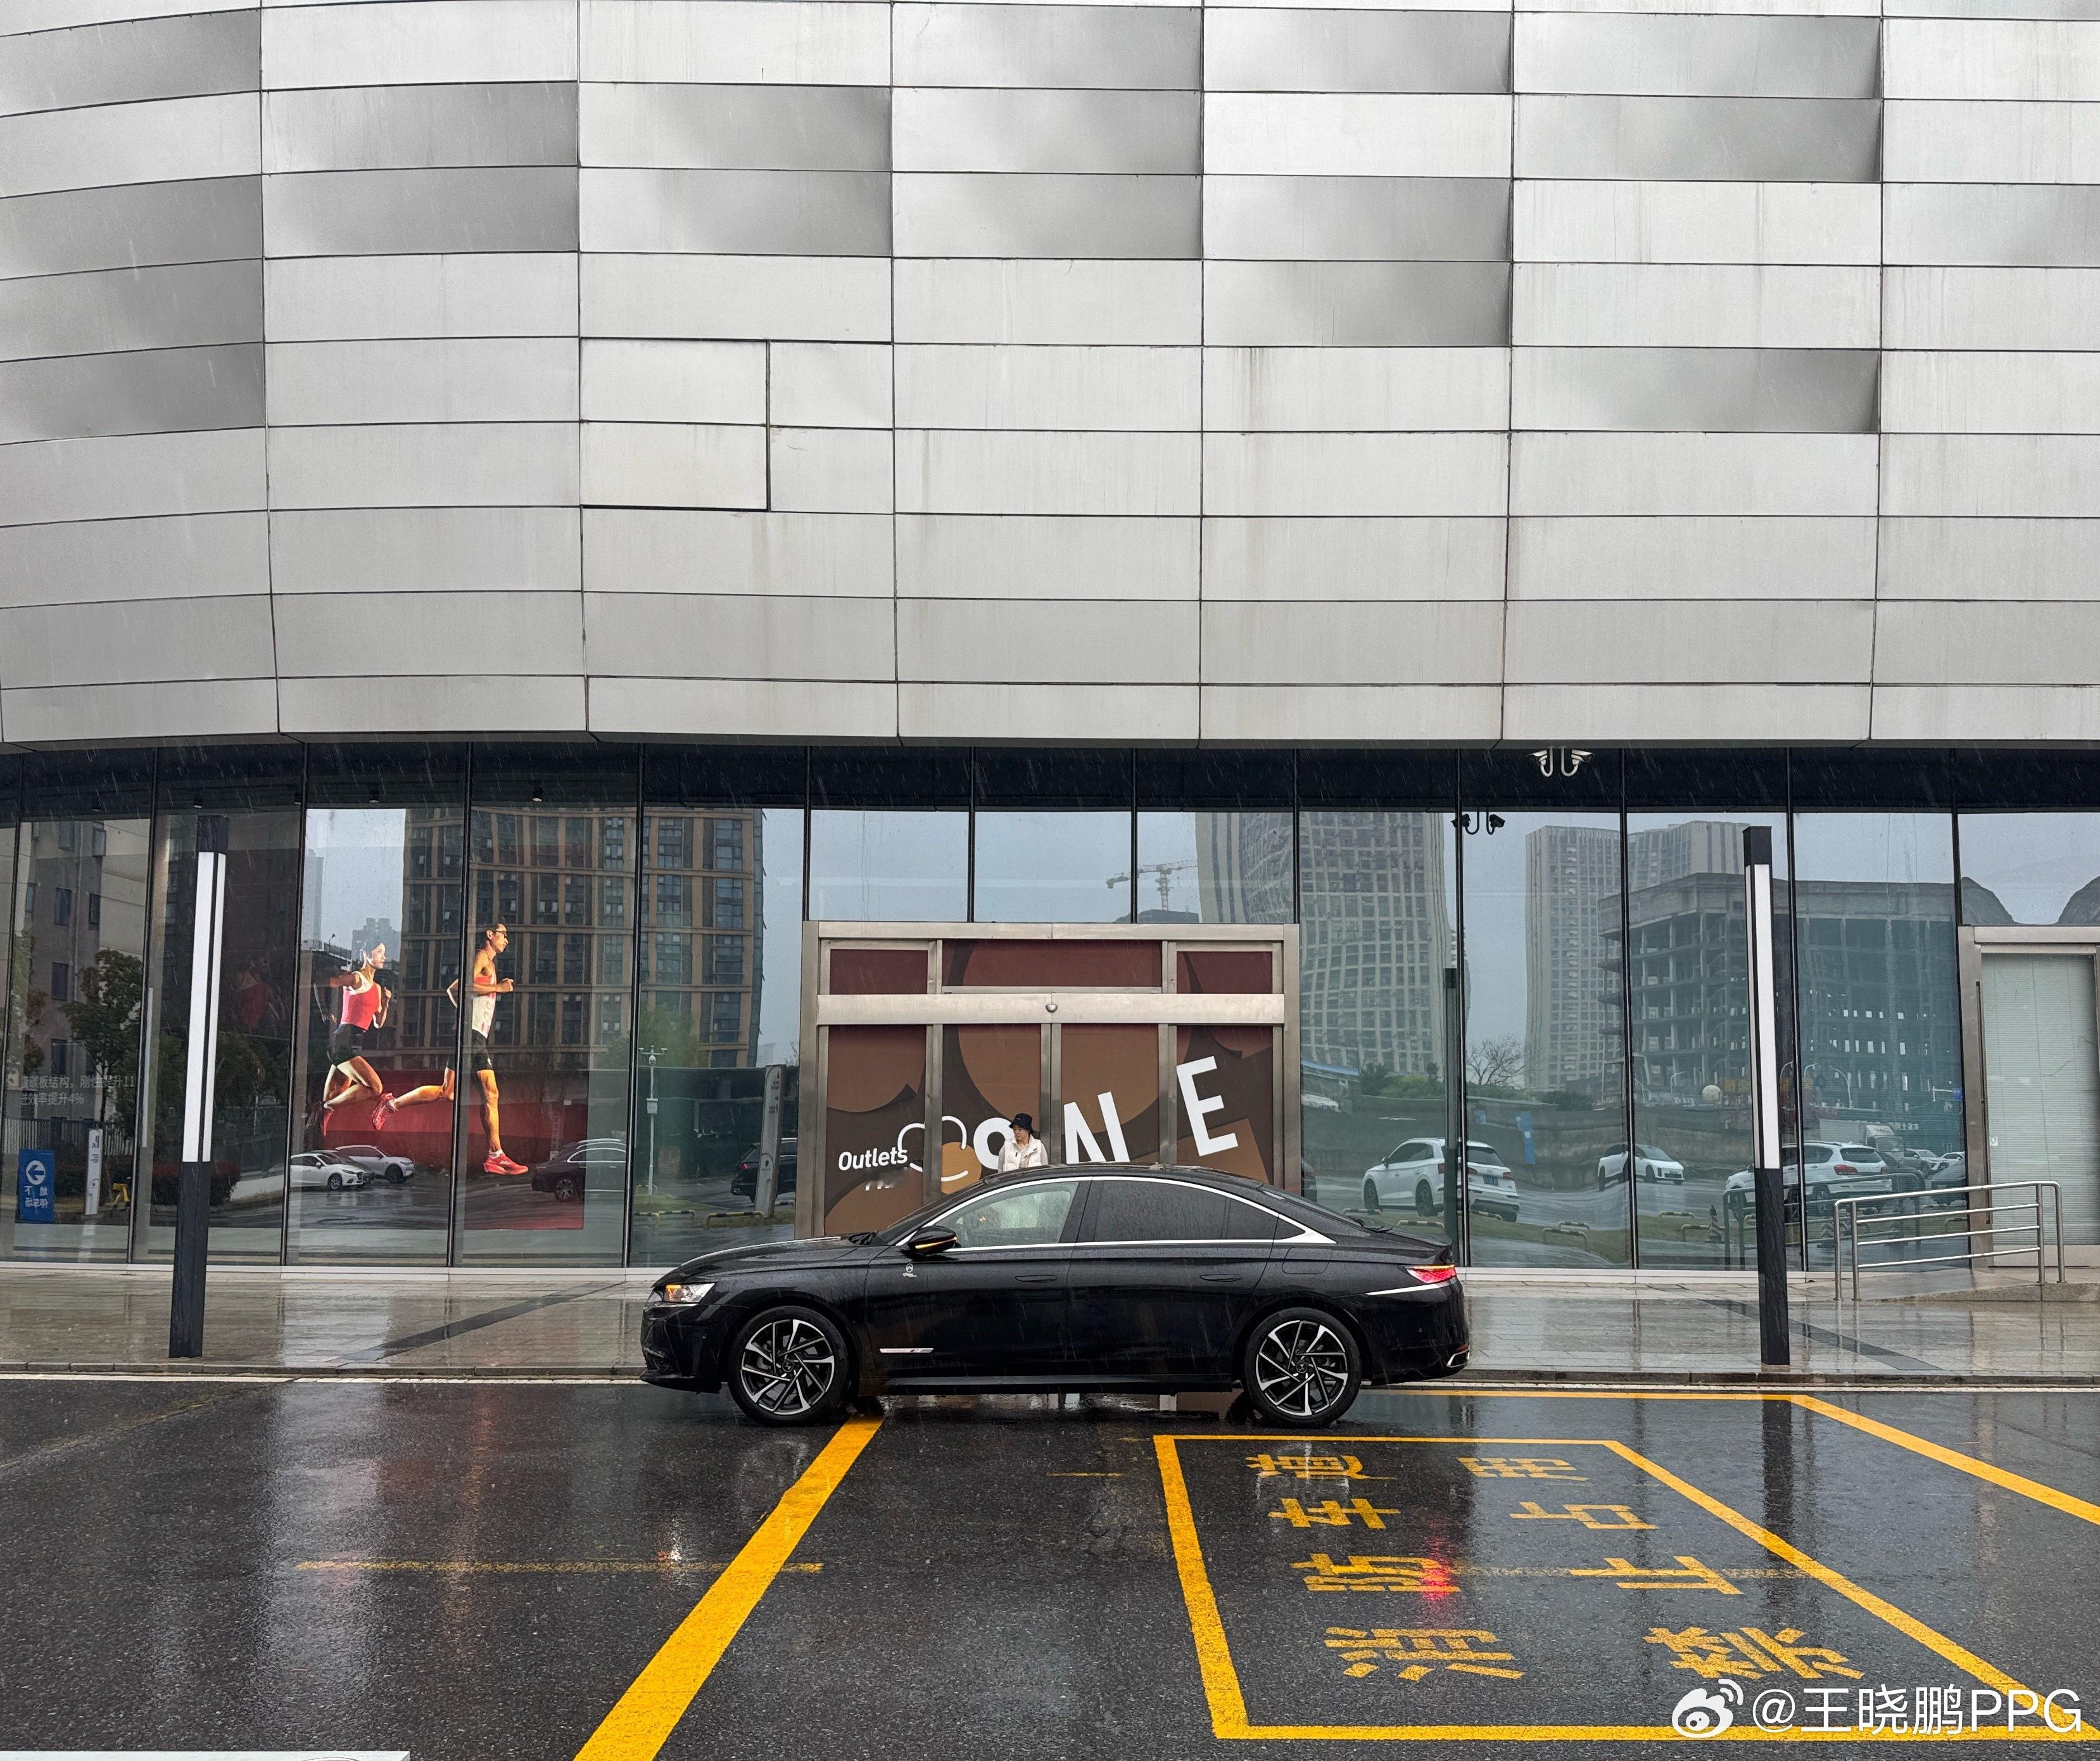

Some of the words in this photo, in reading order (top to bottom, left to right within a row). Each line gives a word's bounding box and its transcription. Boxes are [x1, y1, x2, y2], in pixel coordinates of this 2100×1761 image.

[838, 1147, 908, 1171] Outlets
[1246, 1453, 1523, 1681] 消防车道
[1458, 1456, 1864, 1681] 禁止占用
